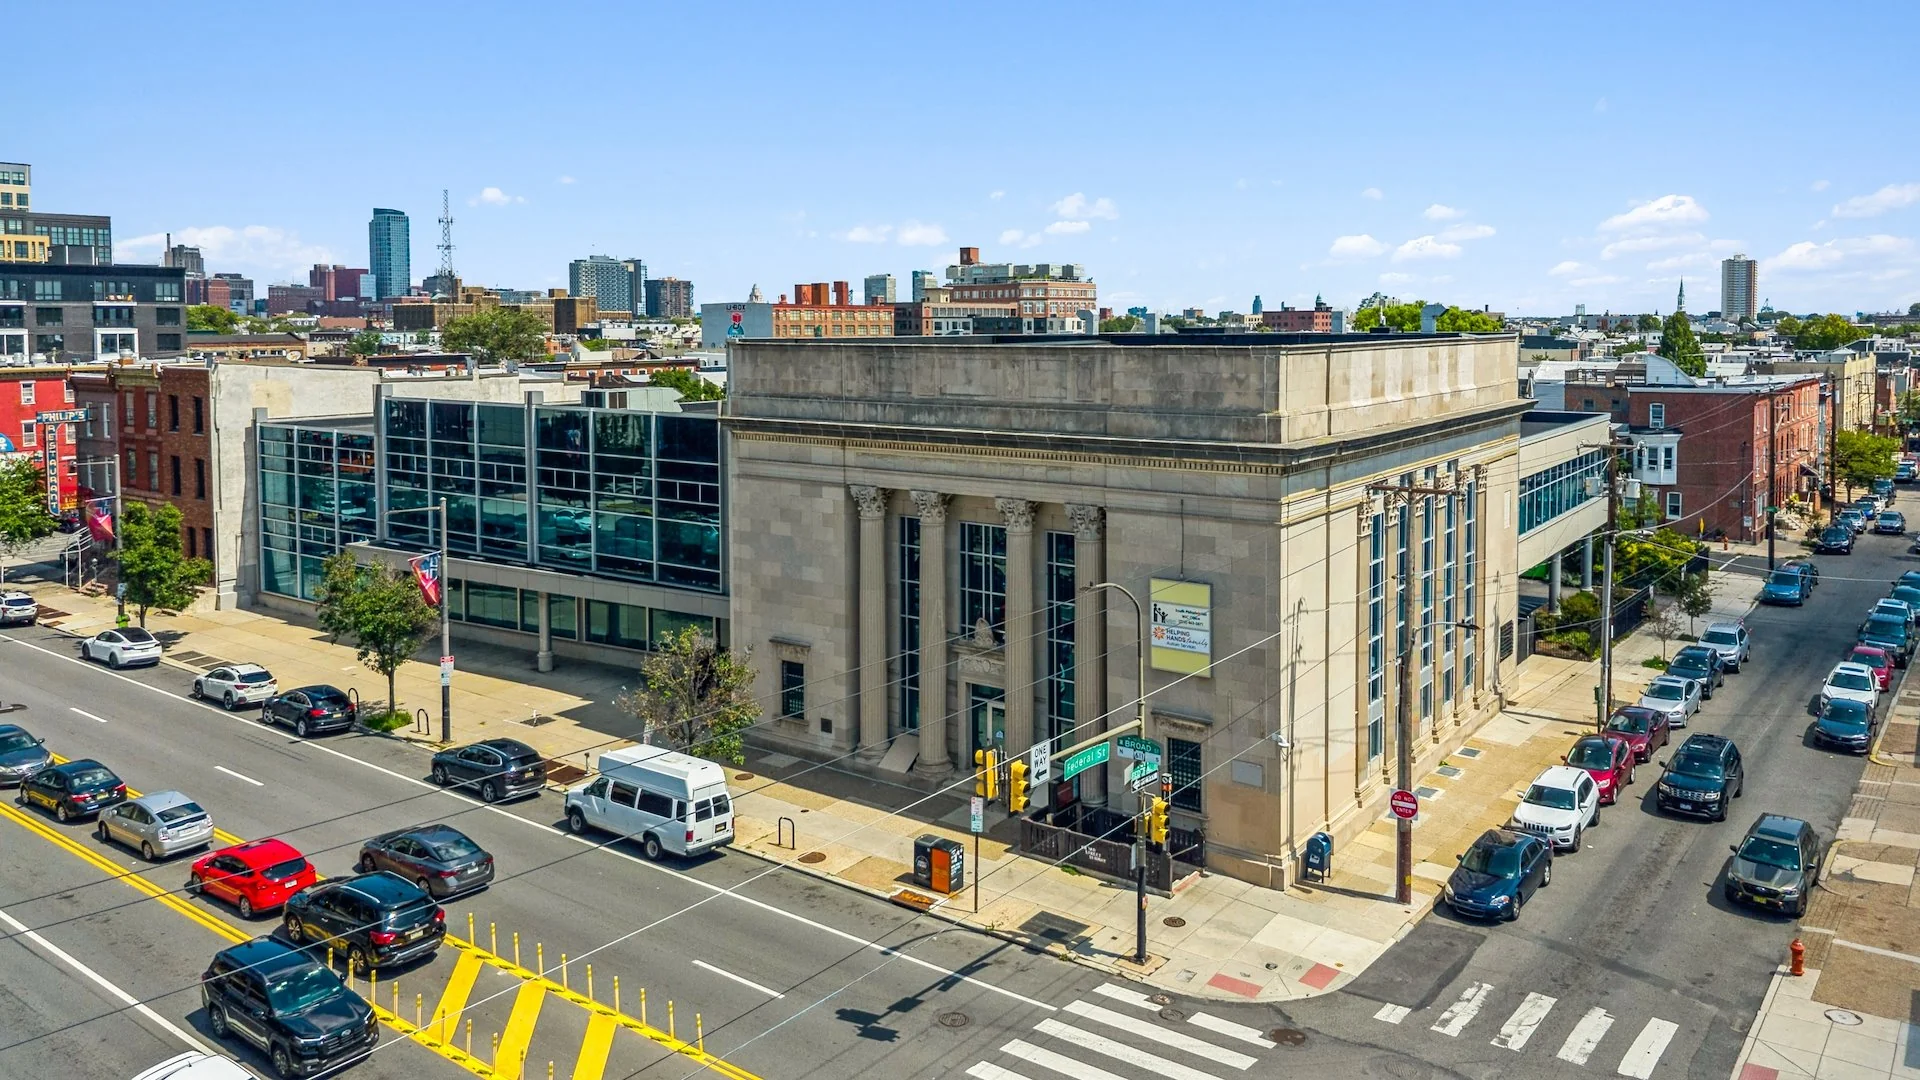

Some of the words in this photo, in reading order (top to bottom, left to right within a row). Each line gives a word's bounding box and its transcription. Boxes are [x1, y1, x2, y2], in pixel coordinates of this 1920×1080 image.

[42, 411, 85, 422] PHILIP'S
[48, 424, 58, 509] RESTAURANT
[1167, 629, 1190, 637] HELPING
[1167, 635, 1186, 643] HANDS
[1034, 745, 1047, 758] ONE
[1125, 740, 1151, 752] BROAD
[1034, 756, 1047, 769] WAY
[1067, 752, 1094, 772] Federal
[1097, 748, 1106, 760] St
